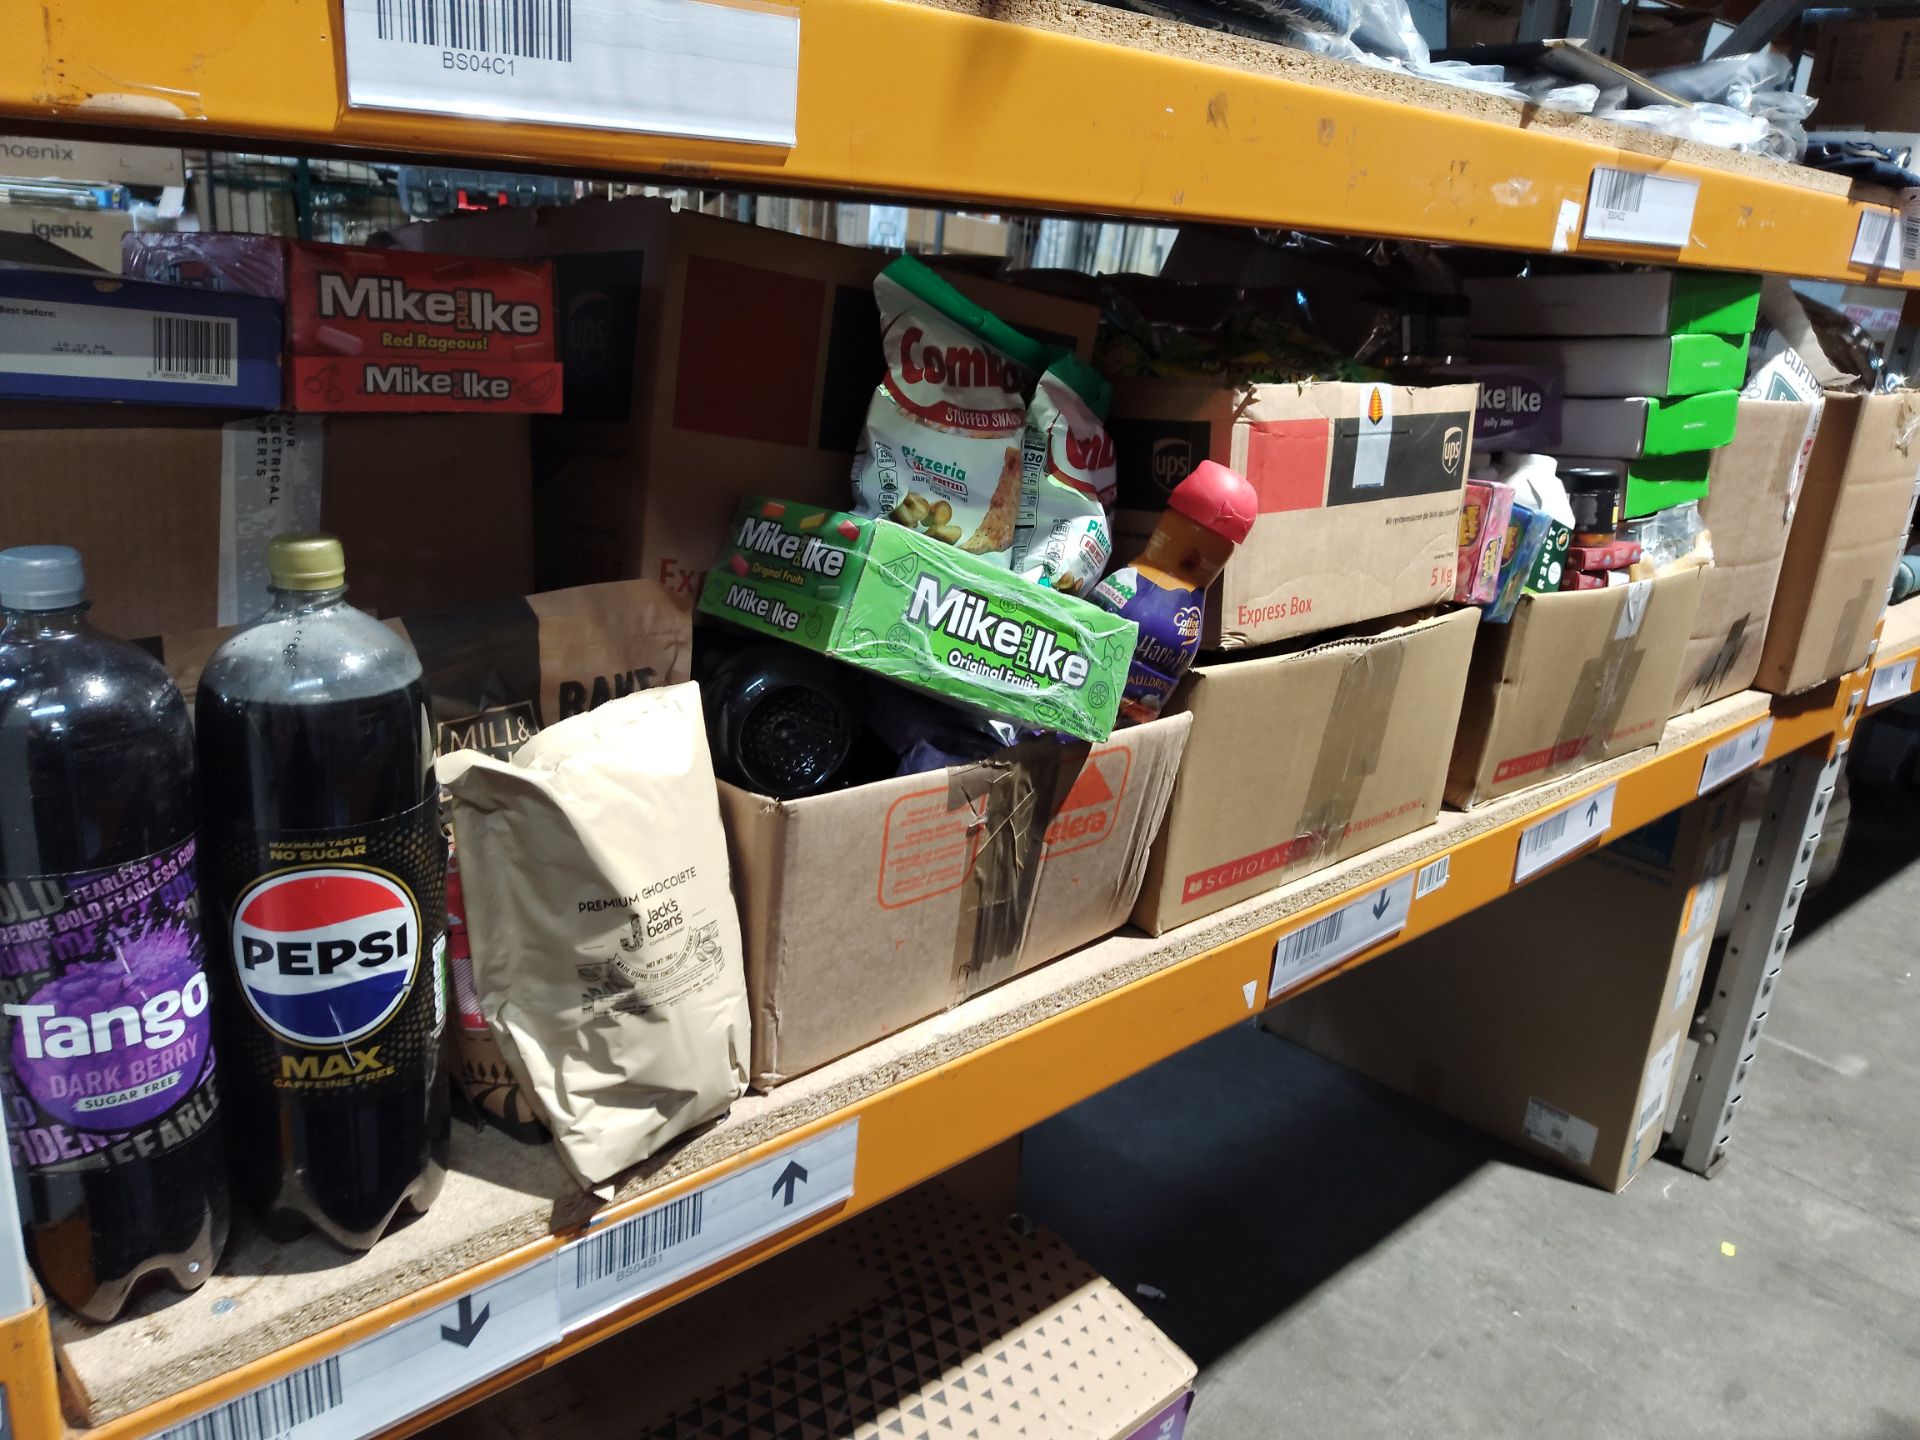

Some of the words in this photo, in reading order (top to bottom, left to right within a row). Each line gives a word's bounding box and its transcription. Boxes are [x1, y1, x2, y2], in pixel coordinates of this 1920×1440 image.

[442, 50, 516, 77] BS04C1
[319, 274, 456, 323] Mike
[472, 291, 540, 333] Ike
[382, 332, 413, 347] Red
[417, 334, 488, 352] Rageous!
[365, 366, 451, 394] Mike
[462, 372, 510, 398] Ike
[945, 406, 989, 427] STUFFED
[901, 445, 967, 481] Pizzeria
[1023, 452, 1043, 463] 130
[1444, 439, 1460, 466] ups
[1155, 454, 1189, 483] ups
[736, 517, 800, 560] Mike
[801, 537, 845, 577] Ike
[752, 562, 782, 580] Original
[1430, 568, 1438, 586] 5
[1440, 568, 1453, 588] Kg
[726, 584, 769, 616] Mike
[771, 601, 799, 630] Ike
[1236, 598, 1287, 627] Express
[1290, 594, 1313, 617] Box
[906, 575, 1023, 656] Mike
[1029, 628, 1091, 688] Ike
[1173, 611, 1200, 636] Coffee
[1177, 625, 1200, 637] mate
[948, 650, 1004, 683] Original
[268, 840, 326, 850] MAXIMUM
[327, 835, 367, 848] TASTE
[270, 849, 296, 861] NO
[301, 844, 367, 861] SUGAR
[54, 901, 104, 932] BOLD
[104, 858, 179, 915] FEARLESS
[73, 862, 149, 904] FEARLESS
[578, 892, 640, 913] PREMIUM
[641, 866, 698, 900] CHOCOLATE
[646, 898, 679, 925] Jack's
[646, 912, 684, 938] beans
[241, 921, 409, 977] PEPSI
[3, 971, 209, 1060] Tango
[50, 1064, 124, 1099] DARK
[128, 1034, 201, 1085] BERRY
[273, 1077, 351, 1090] CAFFEINE
[355, 1064, 396, 1084] FREE
[281, 1045, 383, 1080] MAX
[84, 1090, 138, 1109] SUGAR
[144, 1076, 176, 1095] FREE
[616, 1254, 663, 1282] BS04B1
